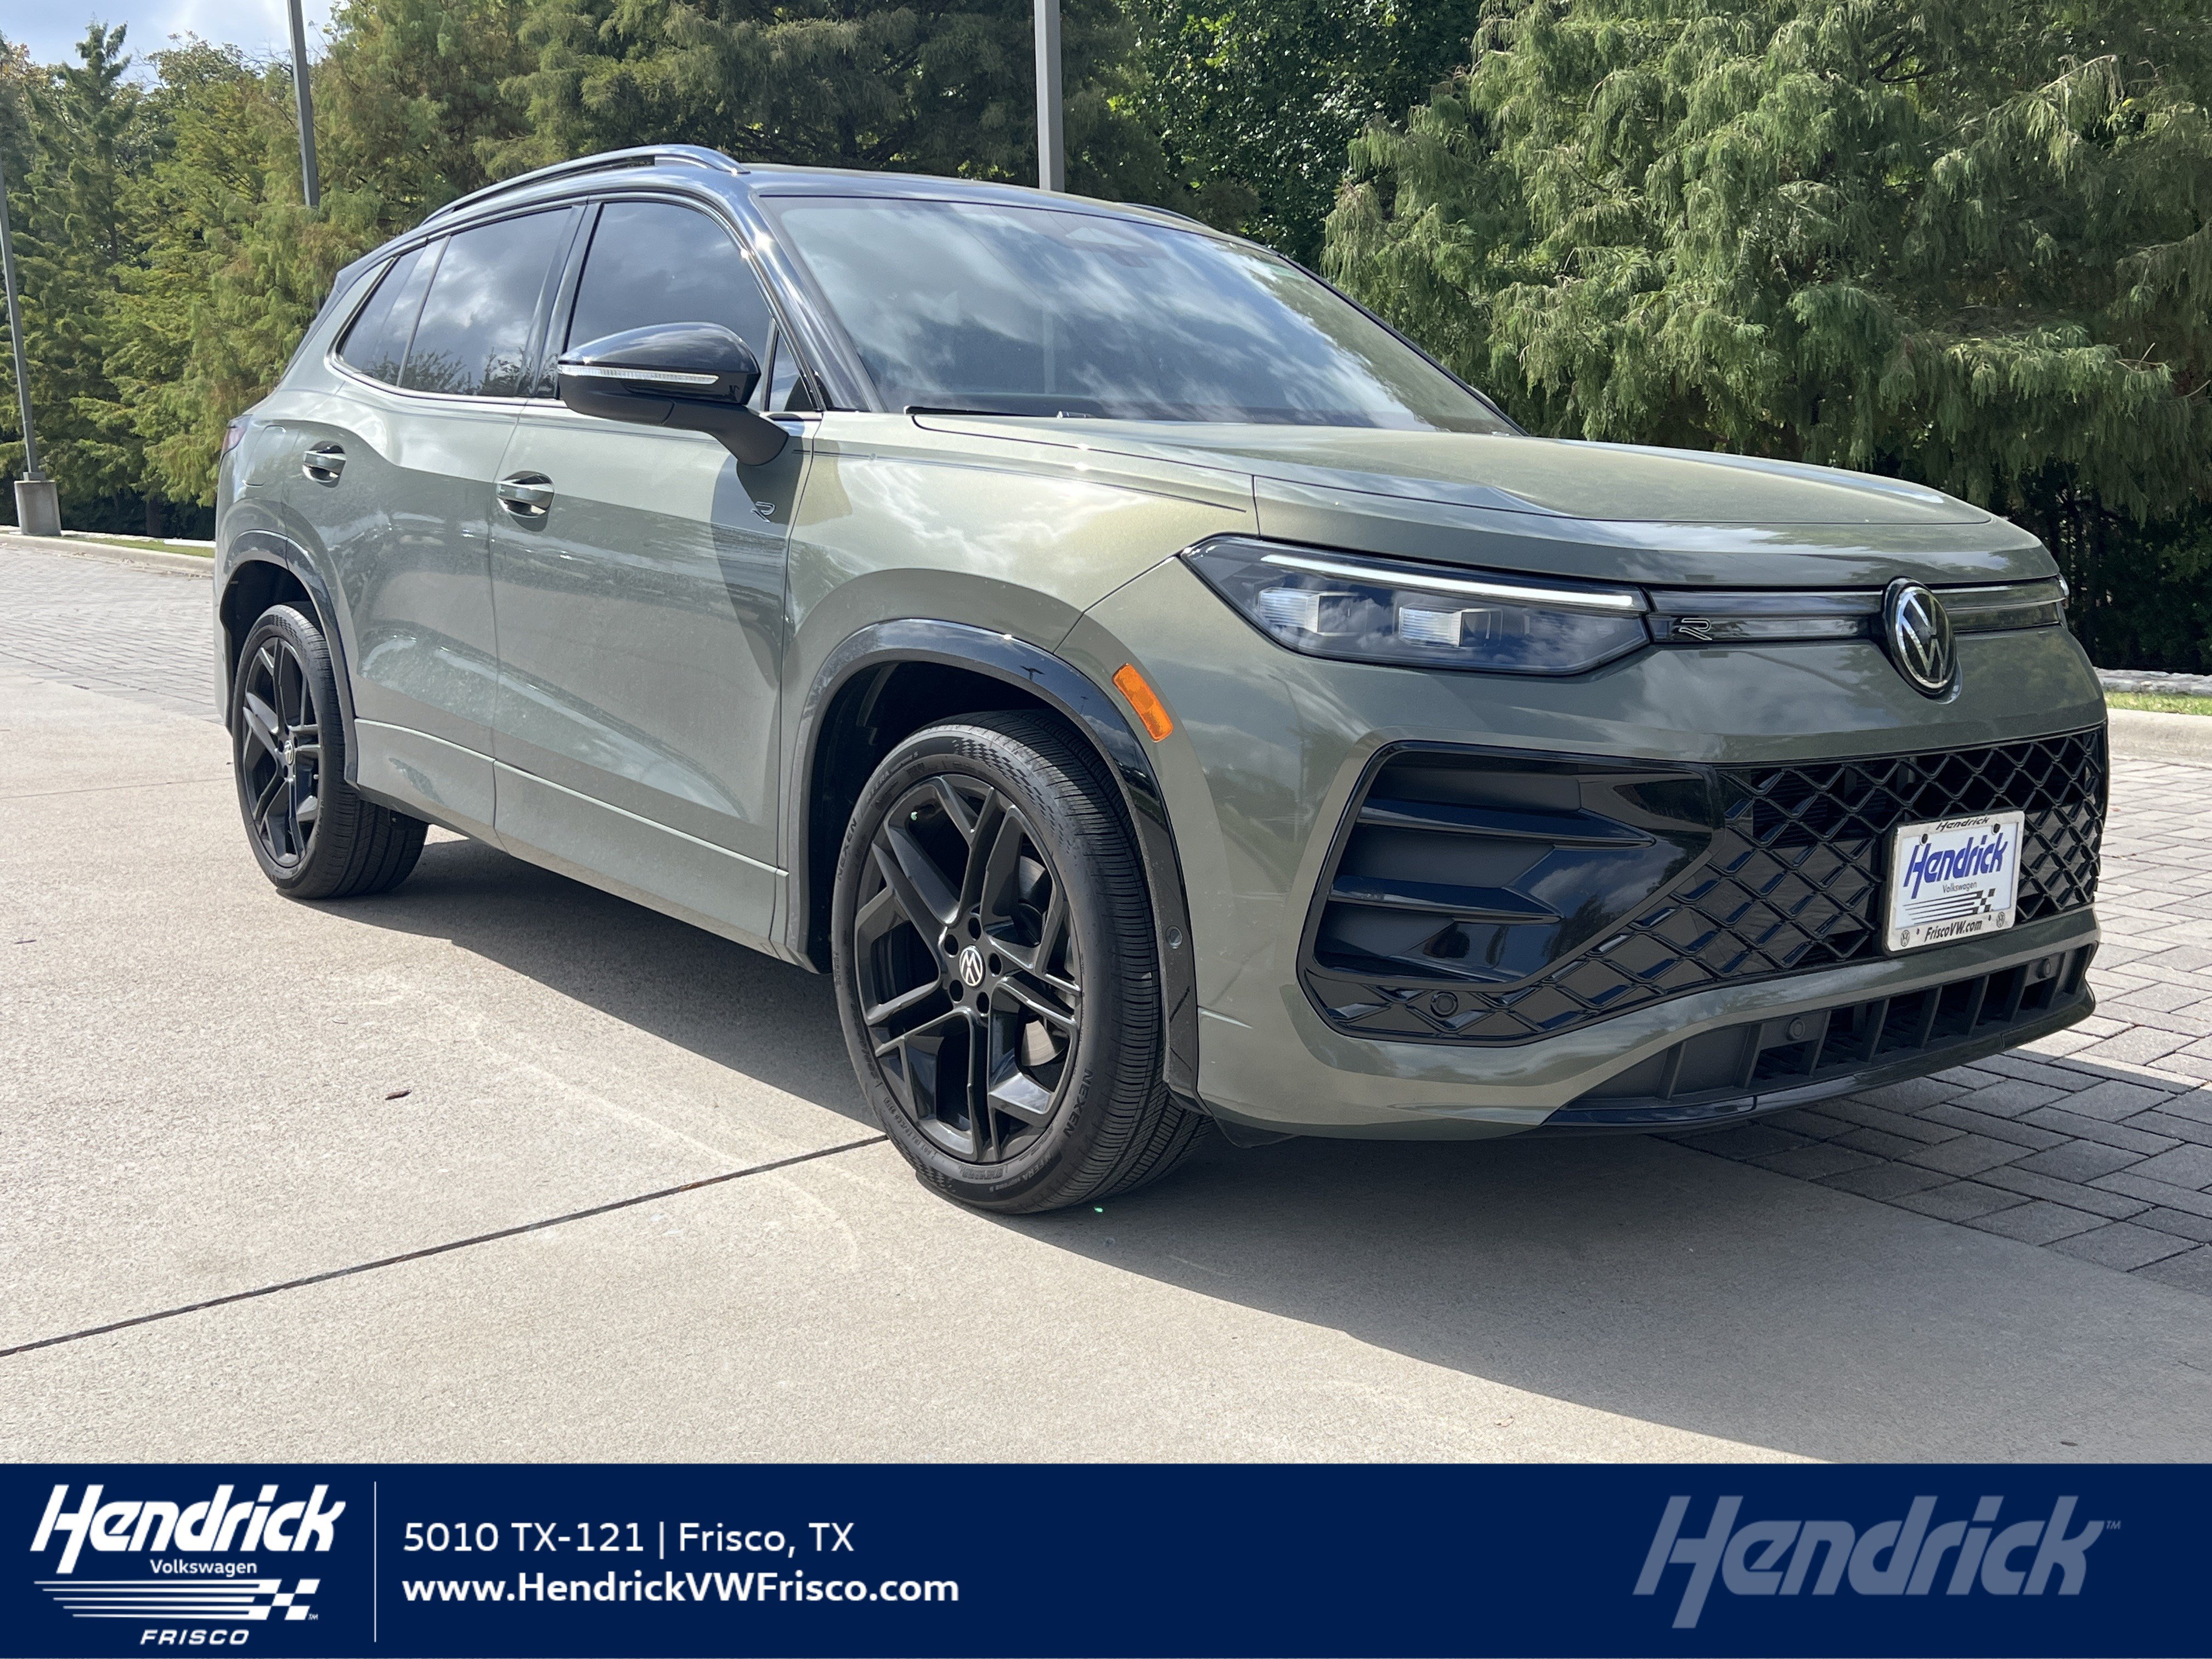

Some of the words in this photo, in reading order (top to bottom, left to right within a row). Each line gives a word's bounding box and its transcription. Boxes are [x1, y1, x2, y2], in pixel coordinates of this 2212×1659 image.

[1936, 816, 1990, 832] Hendrick
[1903, 832, 2008, 900] Hendrick
[1942, 881, 1978, 894] Volkswagen
[1923, 918, 1983, 943] FriscoVW.com
[1063, 1068, 1093, 1138] NEXEN
